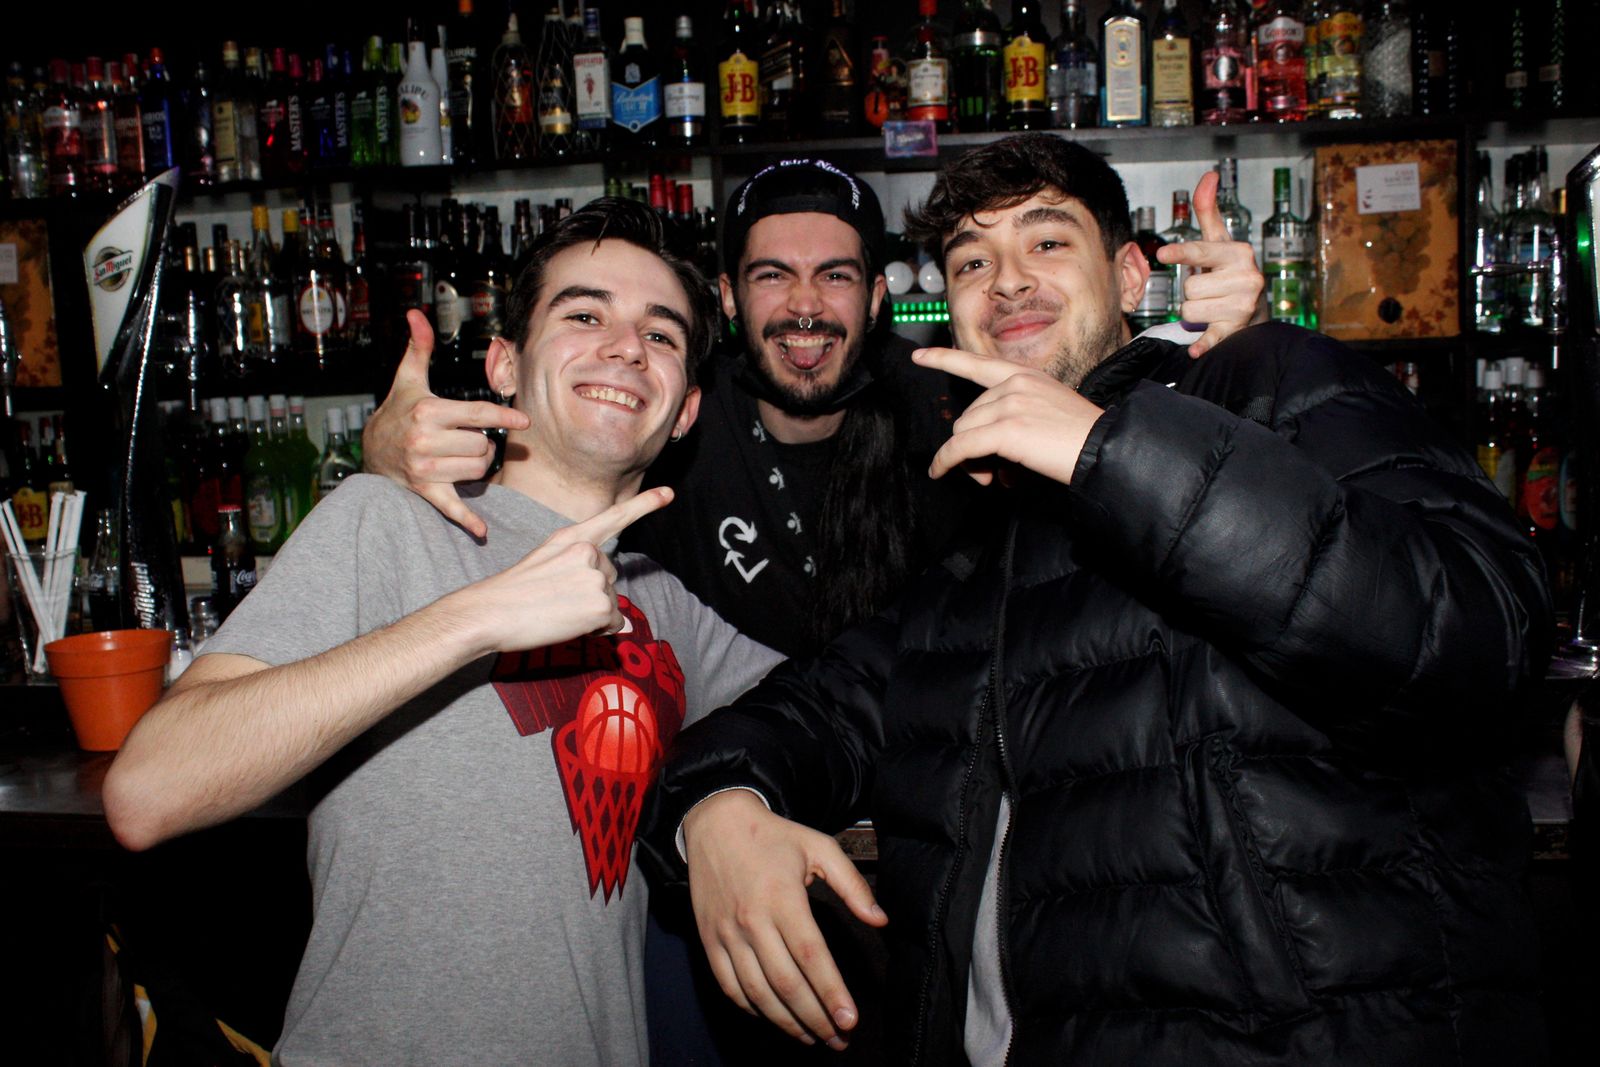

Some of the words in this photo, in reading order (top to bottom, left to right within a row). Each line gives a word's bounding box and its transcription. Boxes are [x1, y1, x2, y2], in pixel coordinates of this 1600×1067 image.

[1007, 55, 1039, 88] J&B
[725, 72, 755, 104] J&B
[105, 255, 132, 274] Miguel
